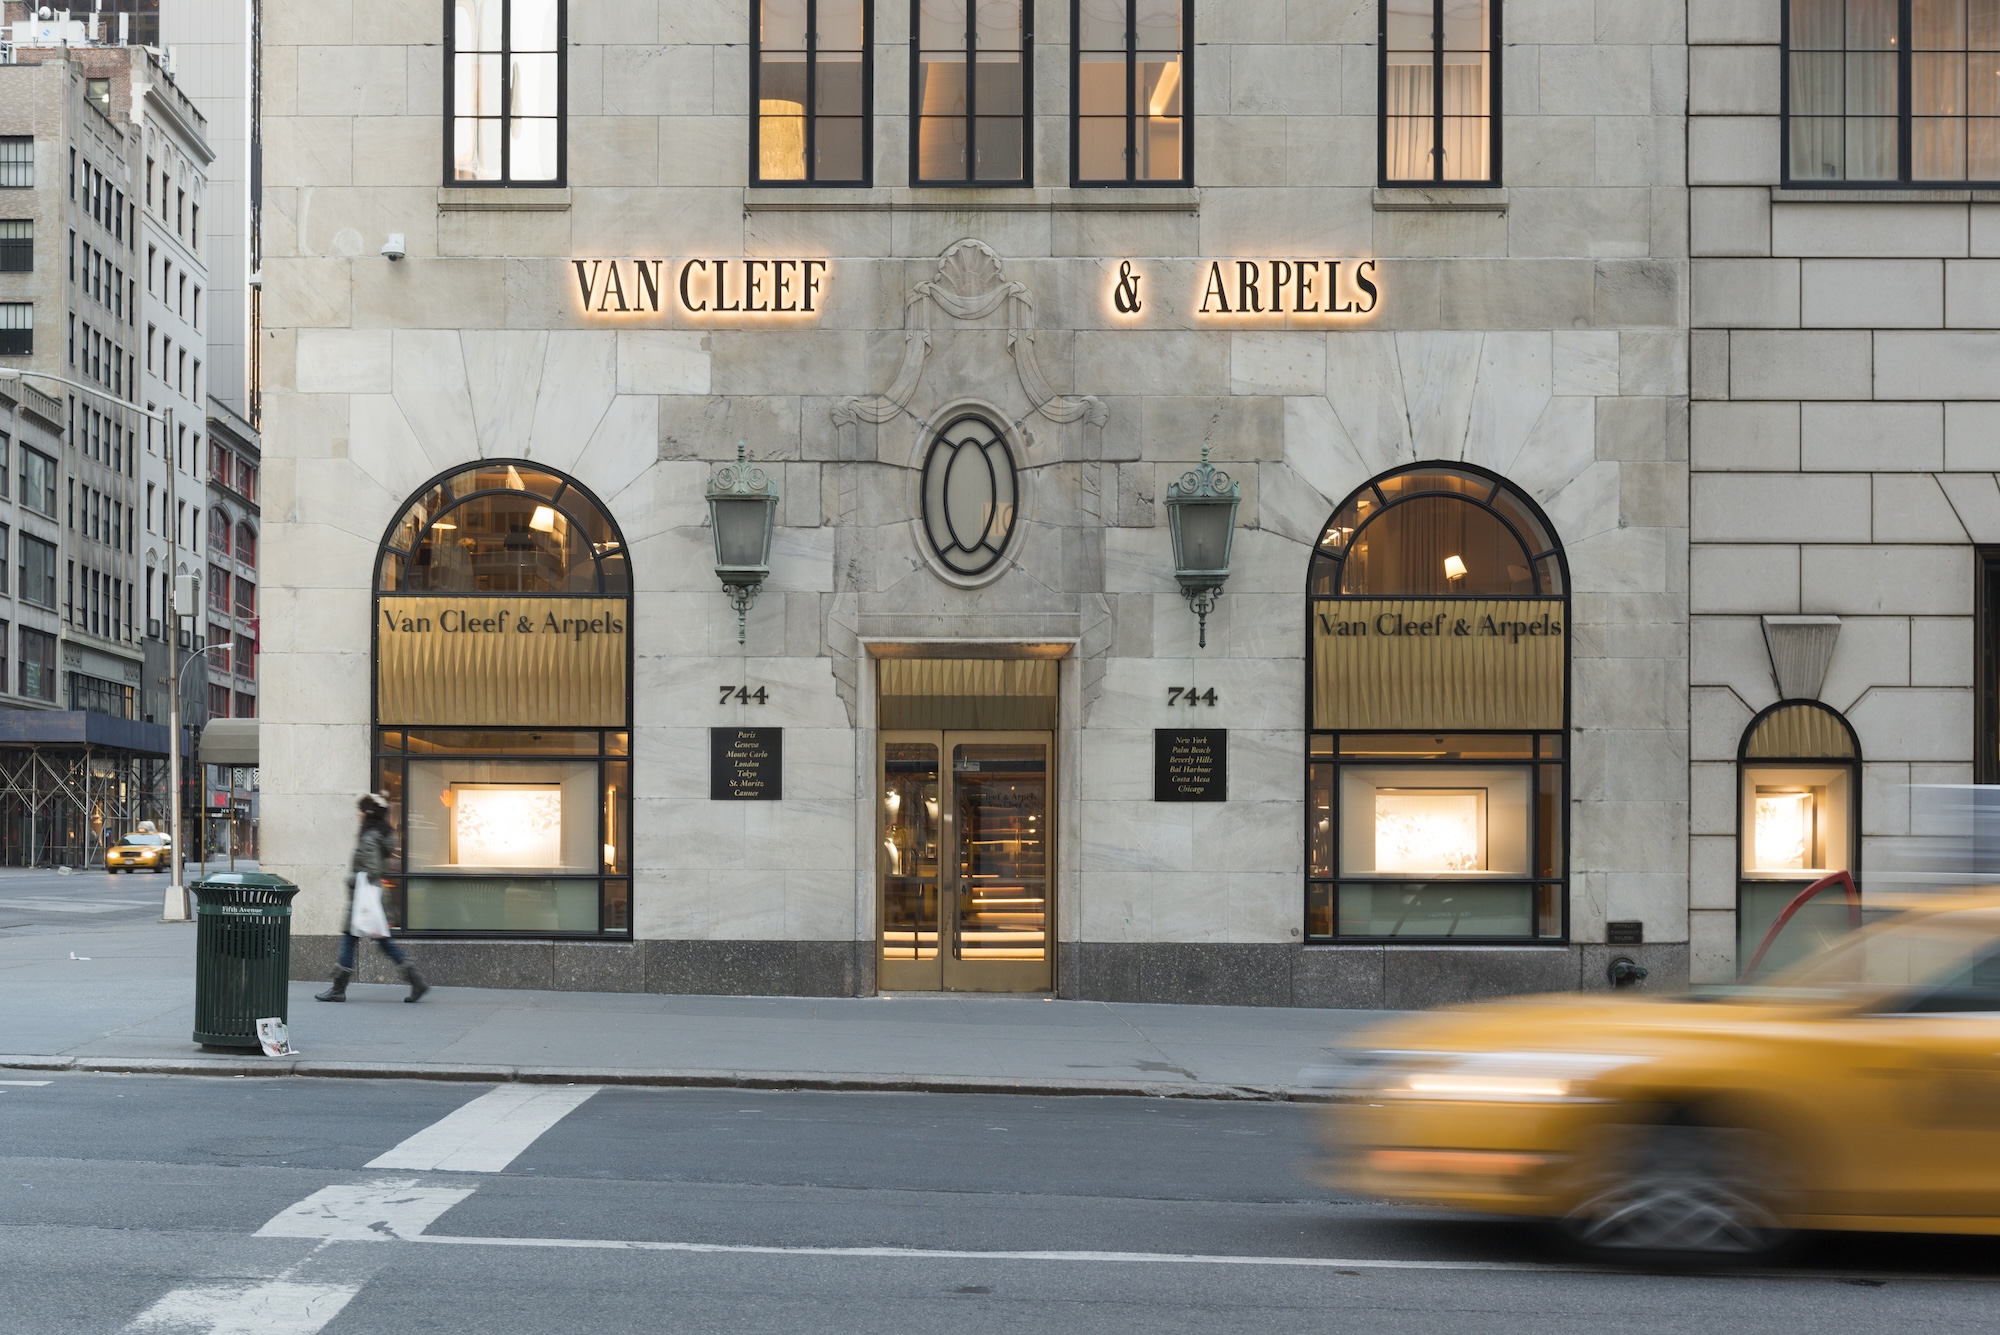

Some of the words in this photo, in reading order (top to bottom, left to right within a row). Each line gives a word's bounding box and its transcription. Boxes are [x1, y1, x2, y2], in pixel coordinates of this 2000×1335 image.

[571, 260, 662, 312] VAN
[680, 259, 826, 312] CLEEF
[1114, 260, 1142, 313] &
[1199, 260, 1378, 313] ARPELS
[384, 610, 430, 632] Van
[440, 610, 510, 633] Cleef
[517, 616, 534, 633] &
[542, 610, 623, 641] Arpels
[1318, 613, 1367, 636] Van
[1376, 613, 1447, 636] Cleef
[1454, 618, 1470, 636] &
[1480, 613, 1562, 644] Arpels
[719, 685, 769, 705] 744
[1167, 686, 1218, 707] 744
[1171, 746, 1189, 754] Palm
[1191, 746, 1211, 754] Beach
[1169, 756, 1194, 765] Beverly
[737, 770, 757, 778] Tokyo
[734, 789, 759, 797] Cannes
[1178, 785, 1205, 795] Chicago
